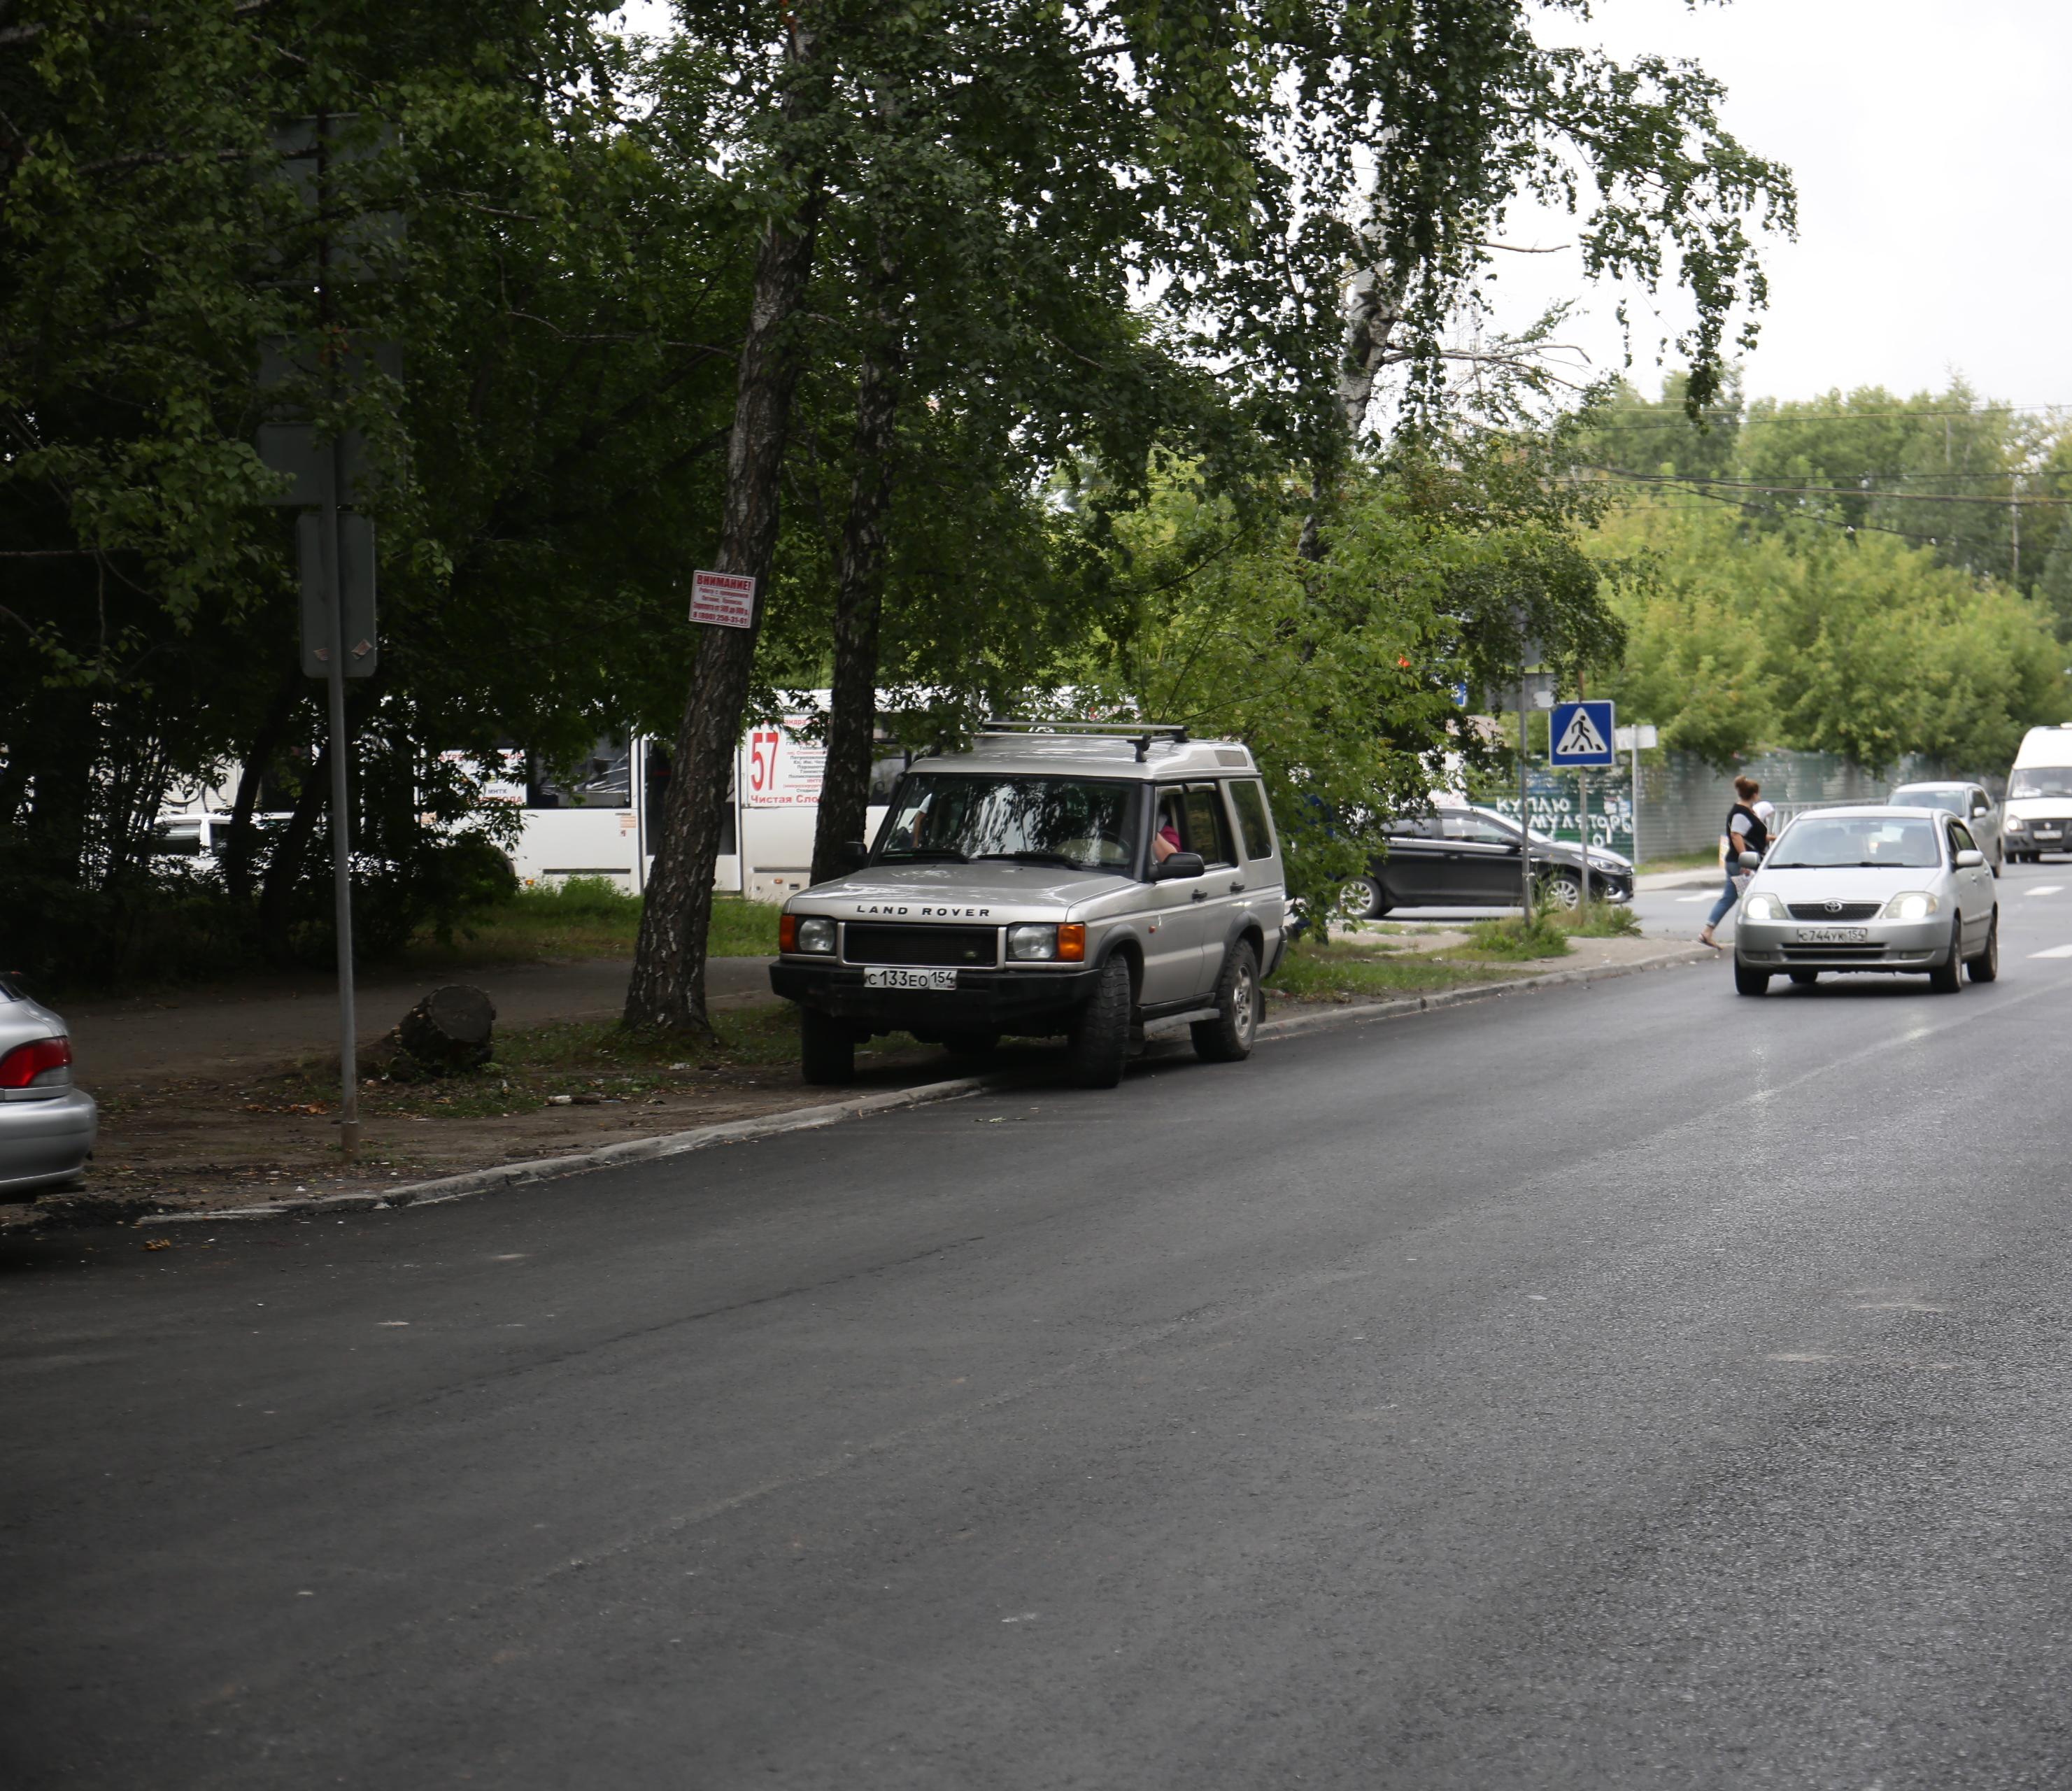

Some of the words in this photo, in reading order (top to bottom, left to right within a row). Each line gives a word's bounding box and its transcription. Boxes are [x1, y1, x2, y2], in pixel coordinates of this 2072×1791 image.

[697, 575, 751, 591] ВНИМАНИЕ!
[751, 732, 779, 791] 57
[751, 795, 792, 804] Чистая
[796, 794, 821, 803] Сло
[856, 905, 908, 915] LAND
[922, 907, 990, 917] ROVER
[867, 970, 928, 987] С133ЕО
[930, 971, 953, 984] 154
